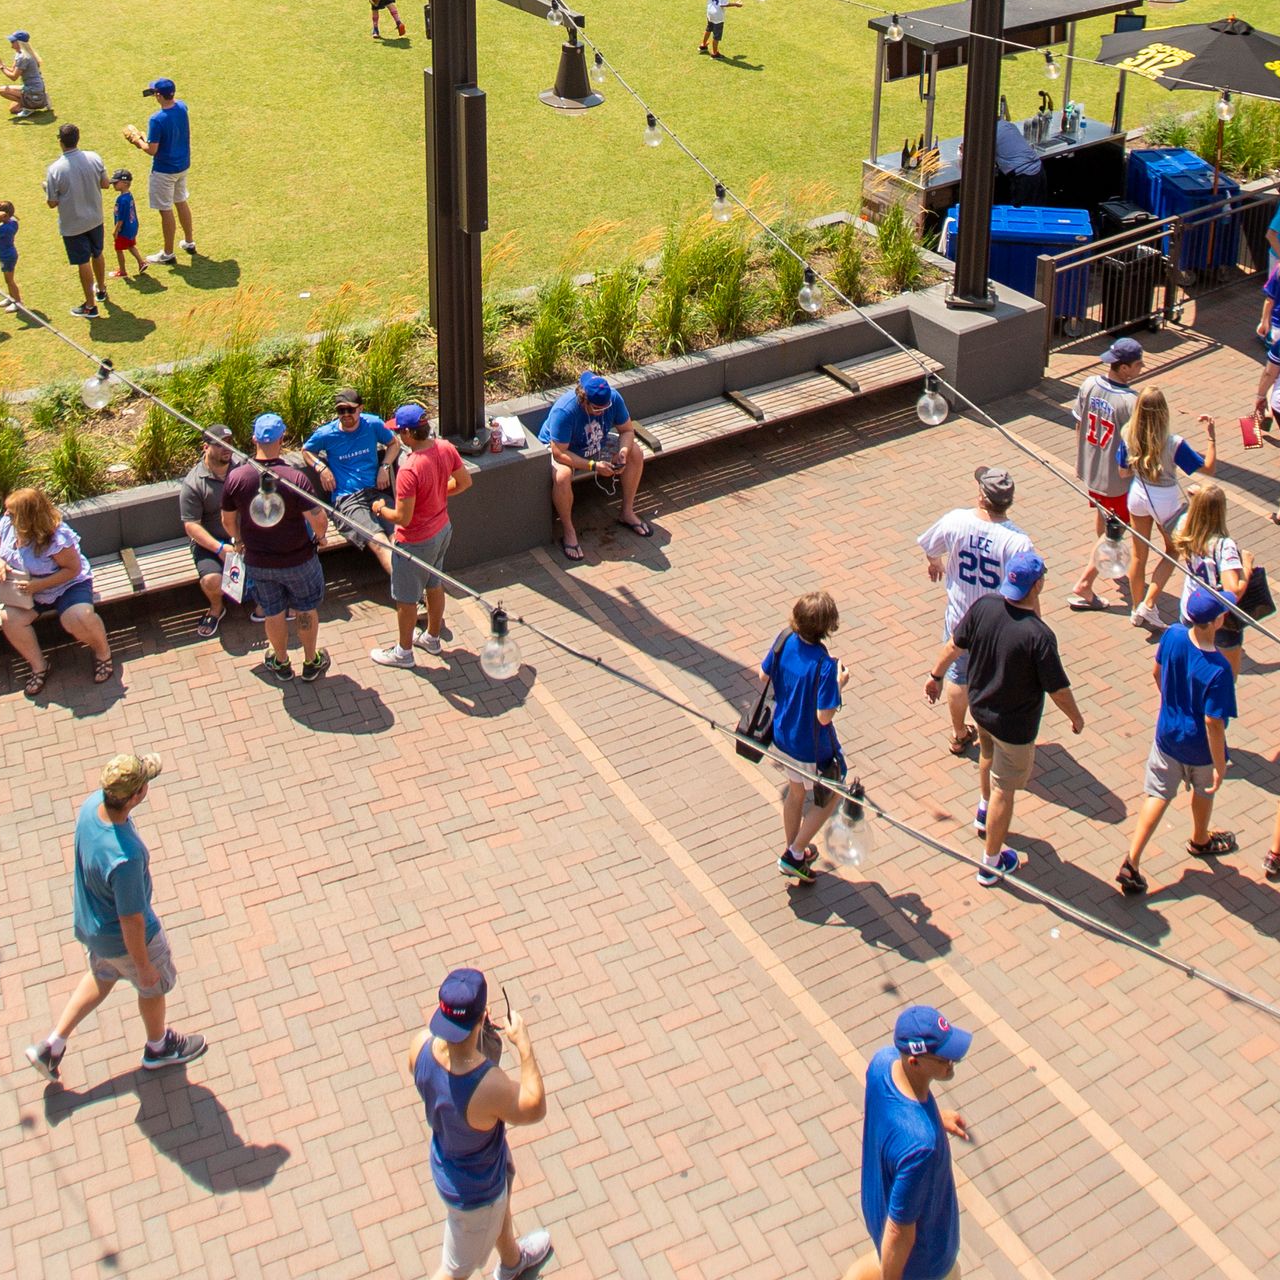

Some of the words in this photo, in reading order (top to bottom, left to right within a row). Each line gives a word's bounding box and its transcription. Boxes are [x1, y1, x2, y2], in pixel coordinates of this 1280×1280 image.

[1123, 47, 1185, 78] 312
[1148, 42, 1197, 62] GOOSE
[1087, 412, 1116, 449] 17
[969, 534, 993, 554] LEE
[958, 550, 1001, 590] 25
